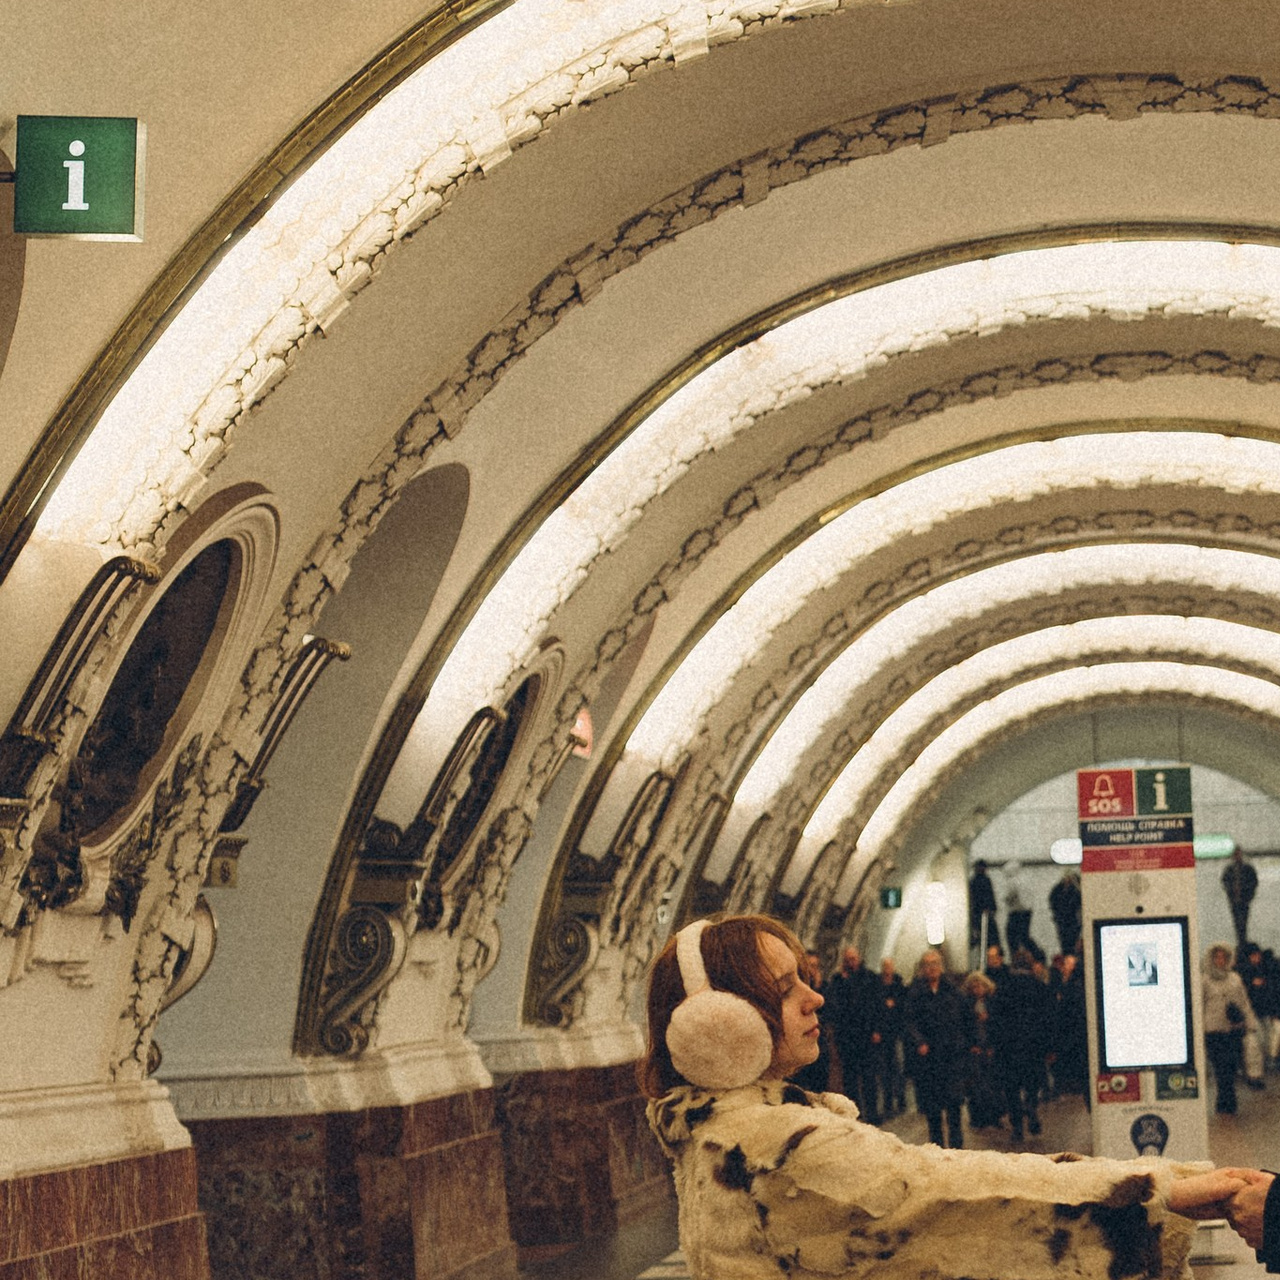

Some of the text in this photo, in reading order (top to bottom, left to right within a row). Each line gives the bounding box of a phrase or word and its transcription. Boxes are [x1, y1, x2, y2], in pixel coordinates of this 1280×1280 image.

[62, 140, 89, 211] i
[1153, 772, 1169, 810] i
[1088, 797, 1122, 814] SOS
[1087, 819, 1185, 832] ПОМОЩЬ СПРАВКА
[1109, 832, 1164, 842] HELP POINT
